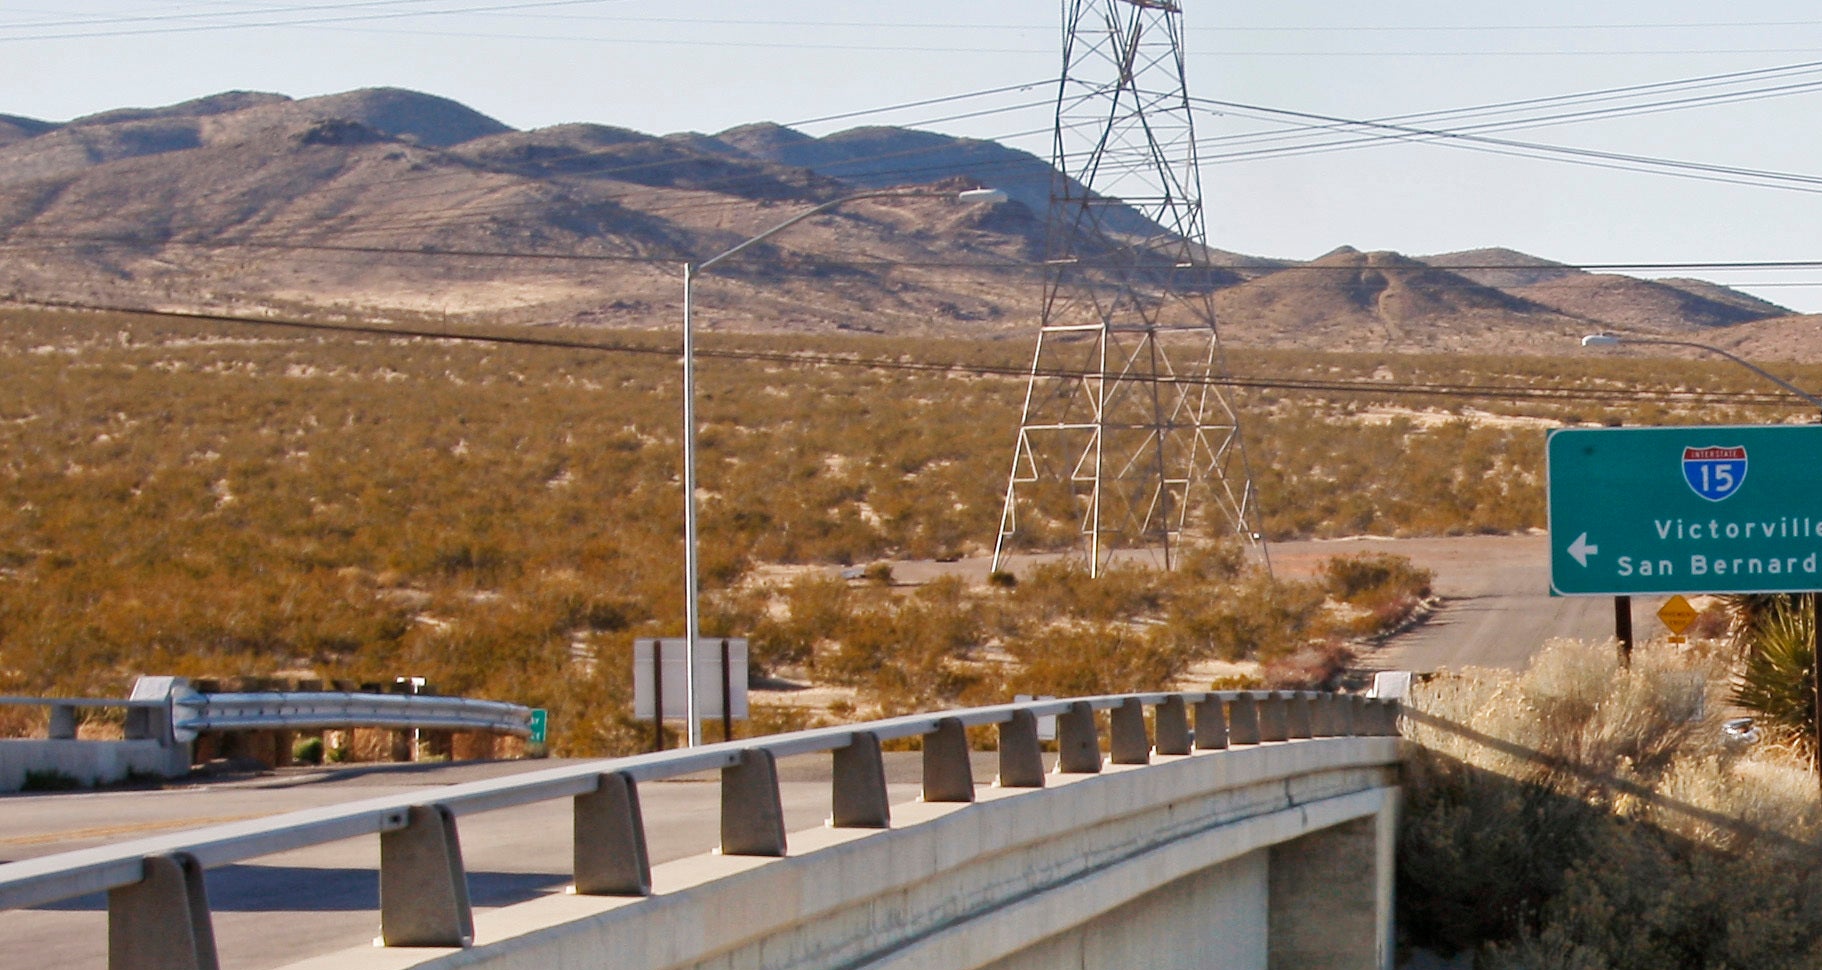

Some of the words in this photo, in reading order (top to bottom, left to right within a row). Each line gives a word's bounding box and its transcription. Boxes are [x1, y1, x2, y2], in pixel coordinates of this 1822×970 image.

[1691, 450, 1737, 458] INTERSTATE
[1701, 464, 1734, 492] 15
[1617, 555, 1673, 577] San
